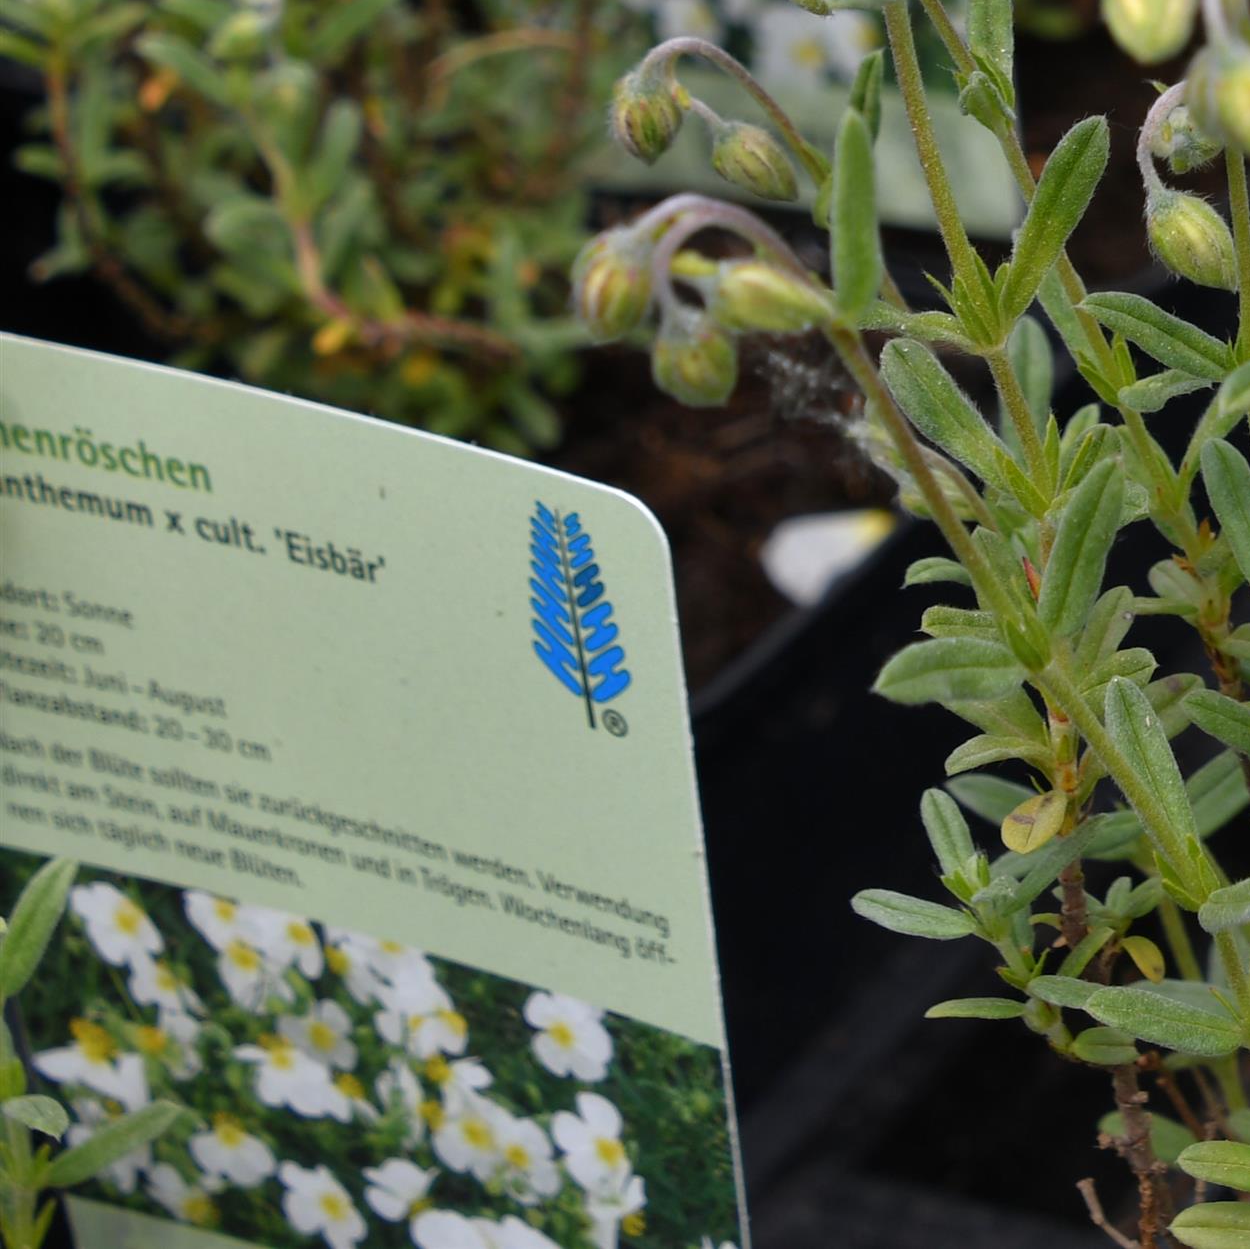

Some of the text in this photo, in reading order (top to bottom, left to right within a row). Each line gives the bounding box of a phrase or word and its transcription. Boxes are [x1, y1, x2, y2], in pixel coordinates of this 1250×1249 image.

[163, 510, 185, 534] x
[194, 516, 266, 554] cult.
[69, 631, 105, 654] cm
[83, 664, 129, 695] Juni
[149, 678, 228, 719] August
[236, 737, 273, 762] cm
[50, 743, 84, 767] der
[150, 765, 221, 799] sollten
[224, 780, 255, 807] sie
[535, 868, 671, 939] Verwendung
[174, 839, 226, 868] neue
[66, 780, 99, 800] am
[352, 852, 392, 880] und
[396, 862, 418, 885] in
[498, 892, 633, 958] Wochenlang
